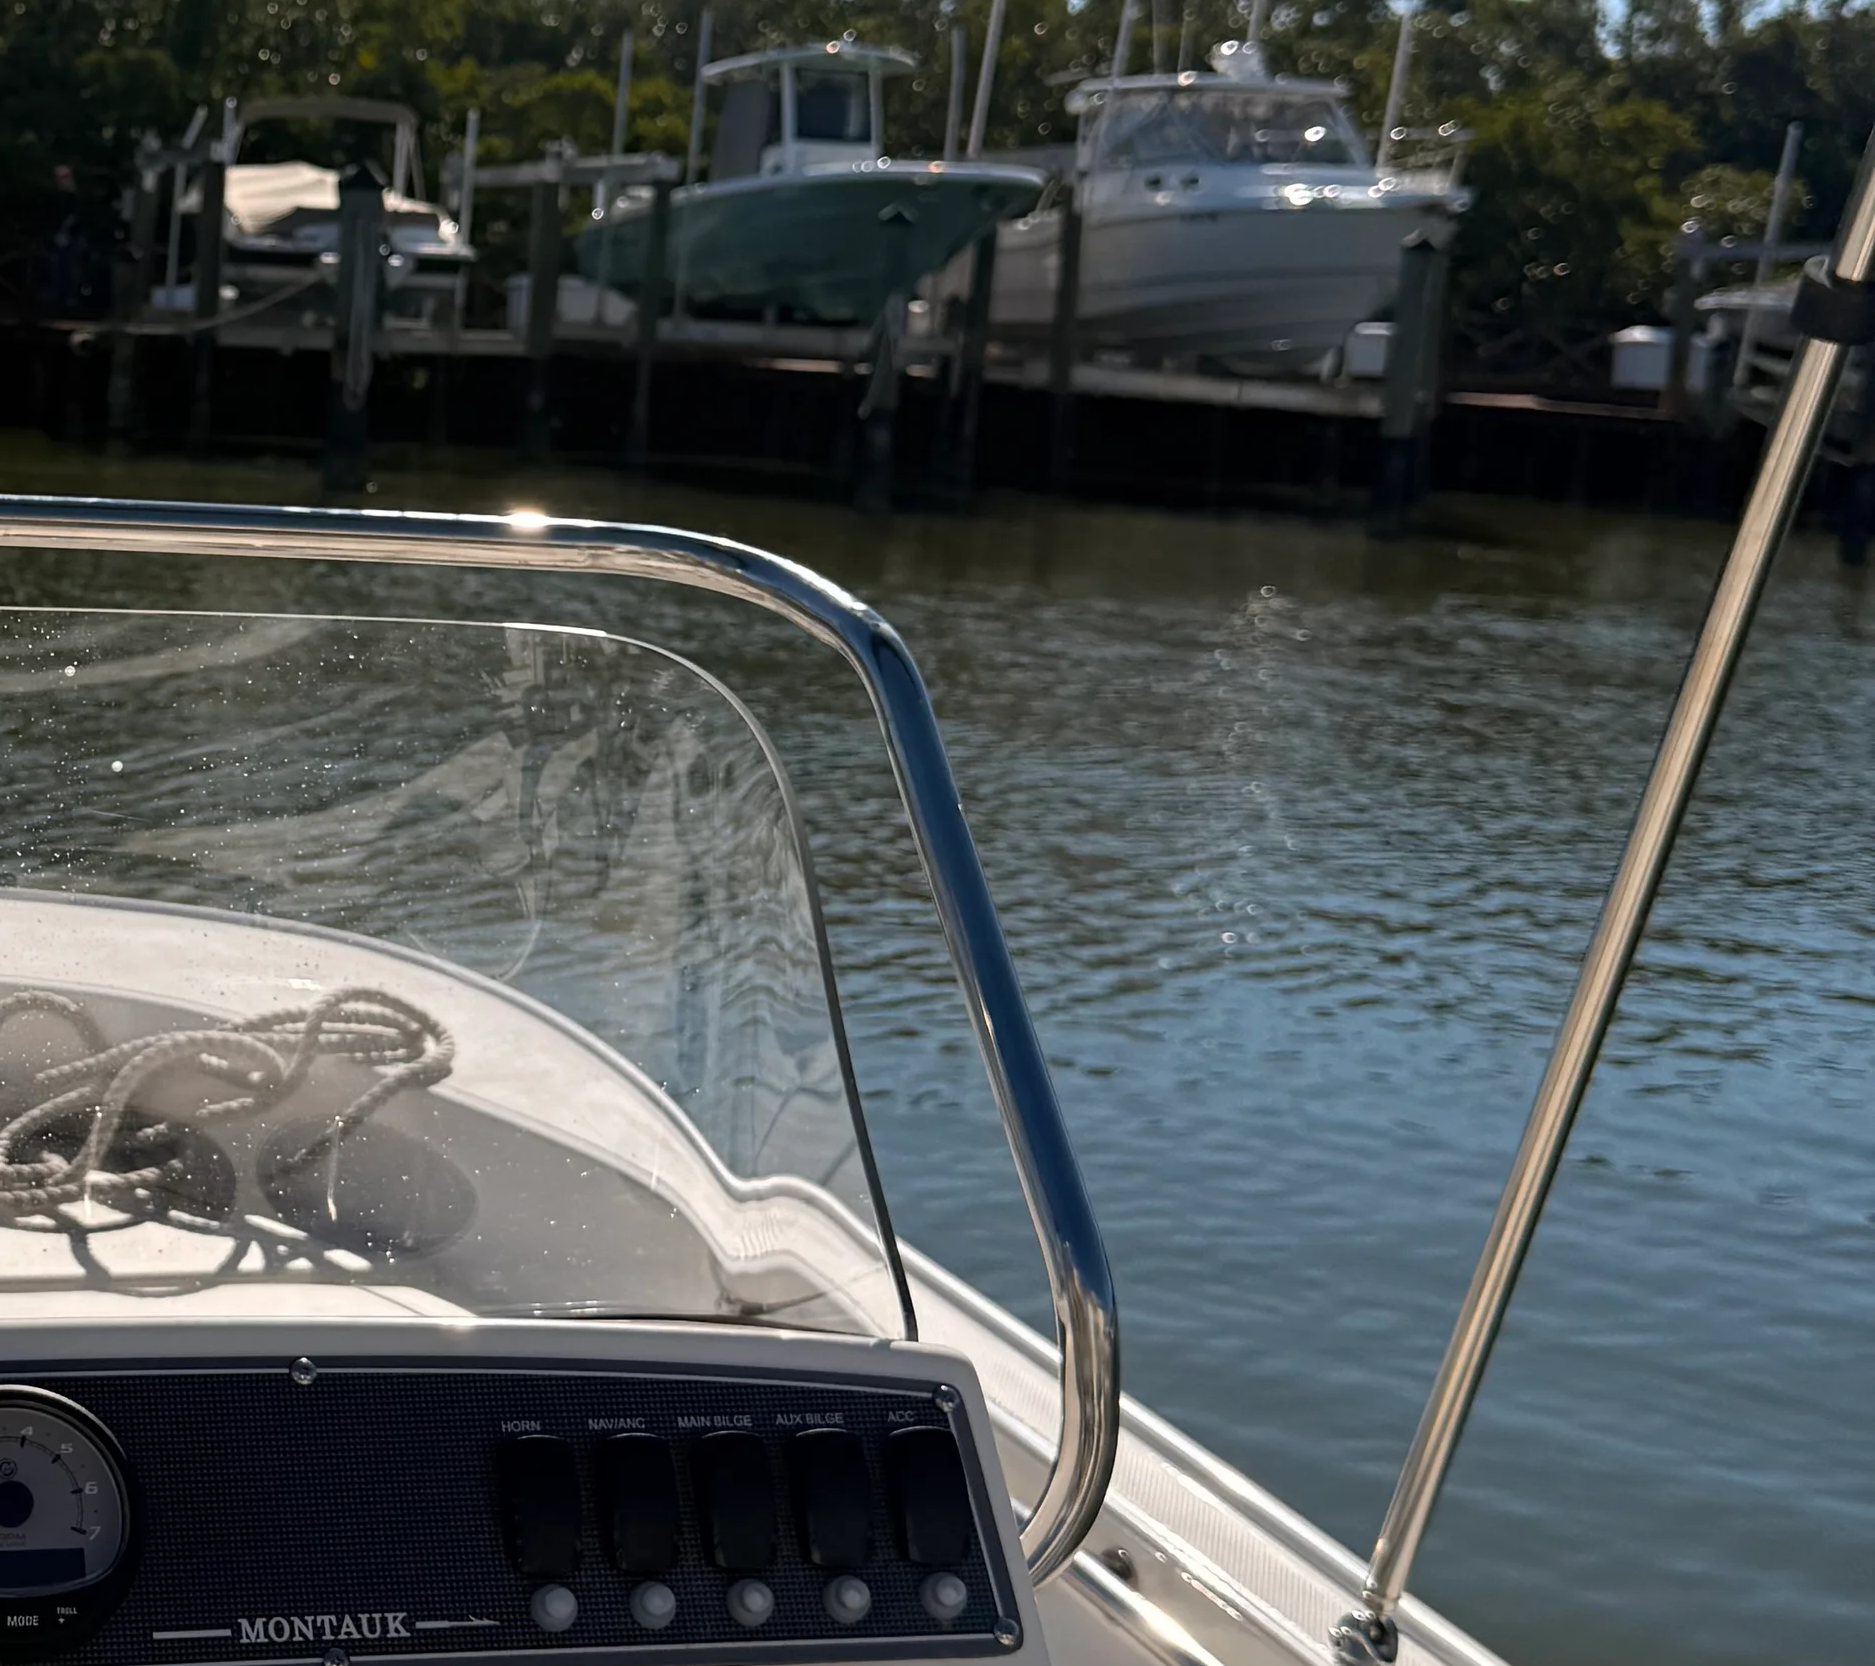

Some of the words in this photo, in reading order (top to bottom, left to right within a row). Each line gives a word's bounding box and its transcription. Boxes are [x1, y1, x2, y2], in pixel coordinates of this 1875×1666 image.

[678, 1416, 711, 1428] MAIN
[713, 1415, 753, 1427] BILGE
[775, 1413, 801, 1425] AUX
[805, 1413, 843, 1425] BILGE
[887, 1411, 914, 1423] ACC
[20, 1426, 33, 1436] 4
[501, 1421, 541, 1433] HORN
[61, 1443, 73, 1453] 5
[85, 1483, 98, 1494] 6
[87, 1527, 101, 1539] 7
[7, 1615, 39, 1627] MODE
[239, 1612, 411, 1643] MONTAUK
